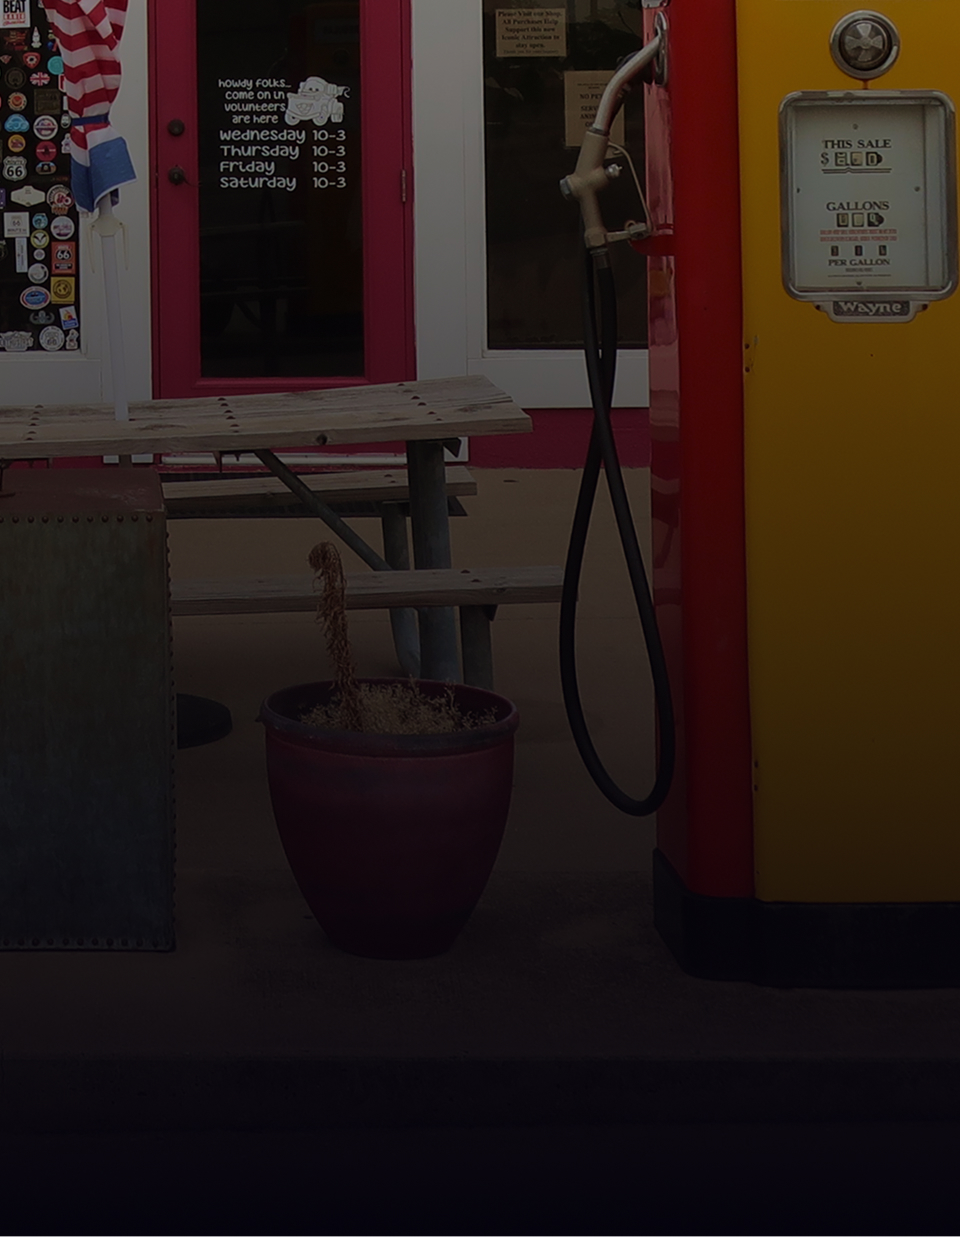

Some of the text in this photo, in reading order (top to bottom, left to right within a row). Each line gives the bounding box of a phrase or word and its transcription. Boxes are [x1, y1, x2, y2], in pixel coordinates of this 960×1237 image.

[3, 0, 27, 14] BEAT
[225, 91, 254, 100] come
[256, 91, 272, 100] on
[224, 102, 287, 112] volunteers
[231, 114, 279, 124] are here
[312, 129, 347, 141] 10-3
[822, 139, 892, 148] THIS SALE
[219, 145, 347, 160] Thursday 10-3
[7, 166, 23, 177] 66
[219, 161, 347, 176] Friday 10-3
[312, 176, 347, 189] 10-3
[826, 201, 890, 211] GALLONS
[828, 258, 891, 266] PER GALLON
[839, 300, 903, 315] Wayne
